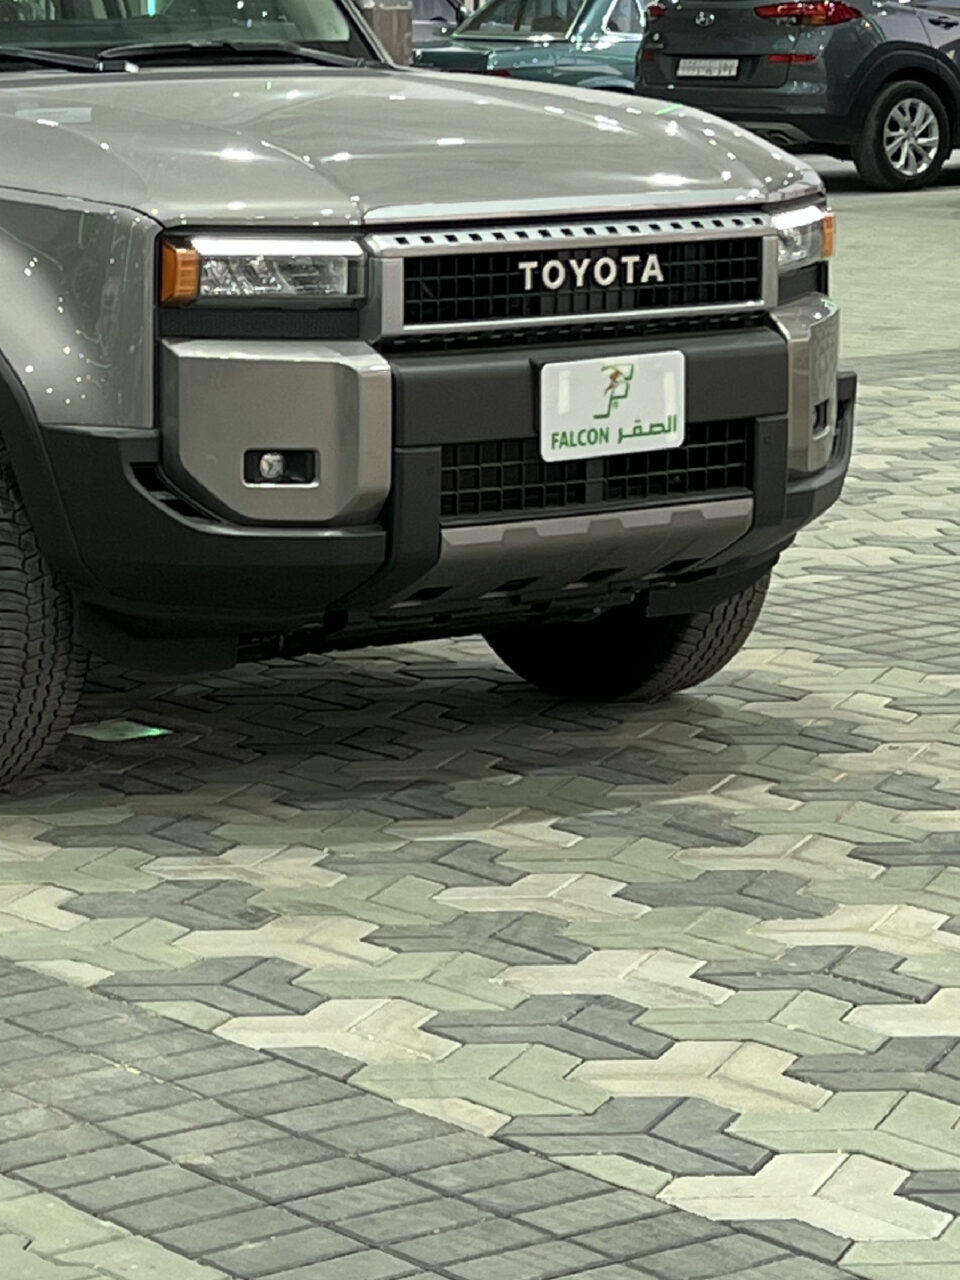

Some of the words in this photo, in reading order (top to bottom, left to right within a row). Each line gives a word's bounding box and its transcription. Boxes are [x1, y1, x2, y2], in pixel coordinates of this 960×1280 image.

[518, 253, 664, 291] TOYOTA
[551, 427, 610, 450] FALCON
[617, 415, 677, 444] الصقر
